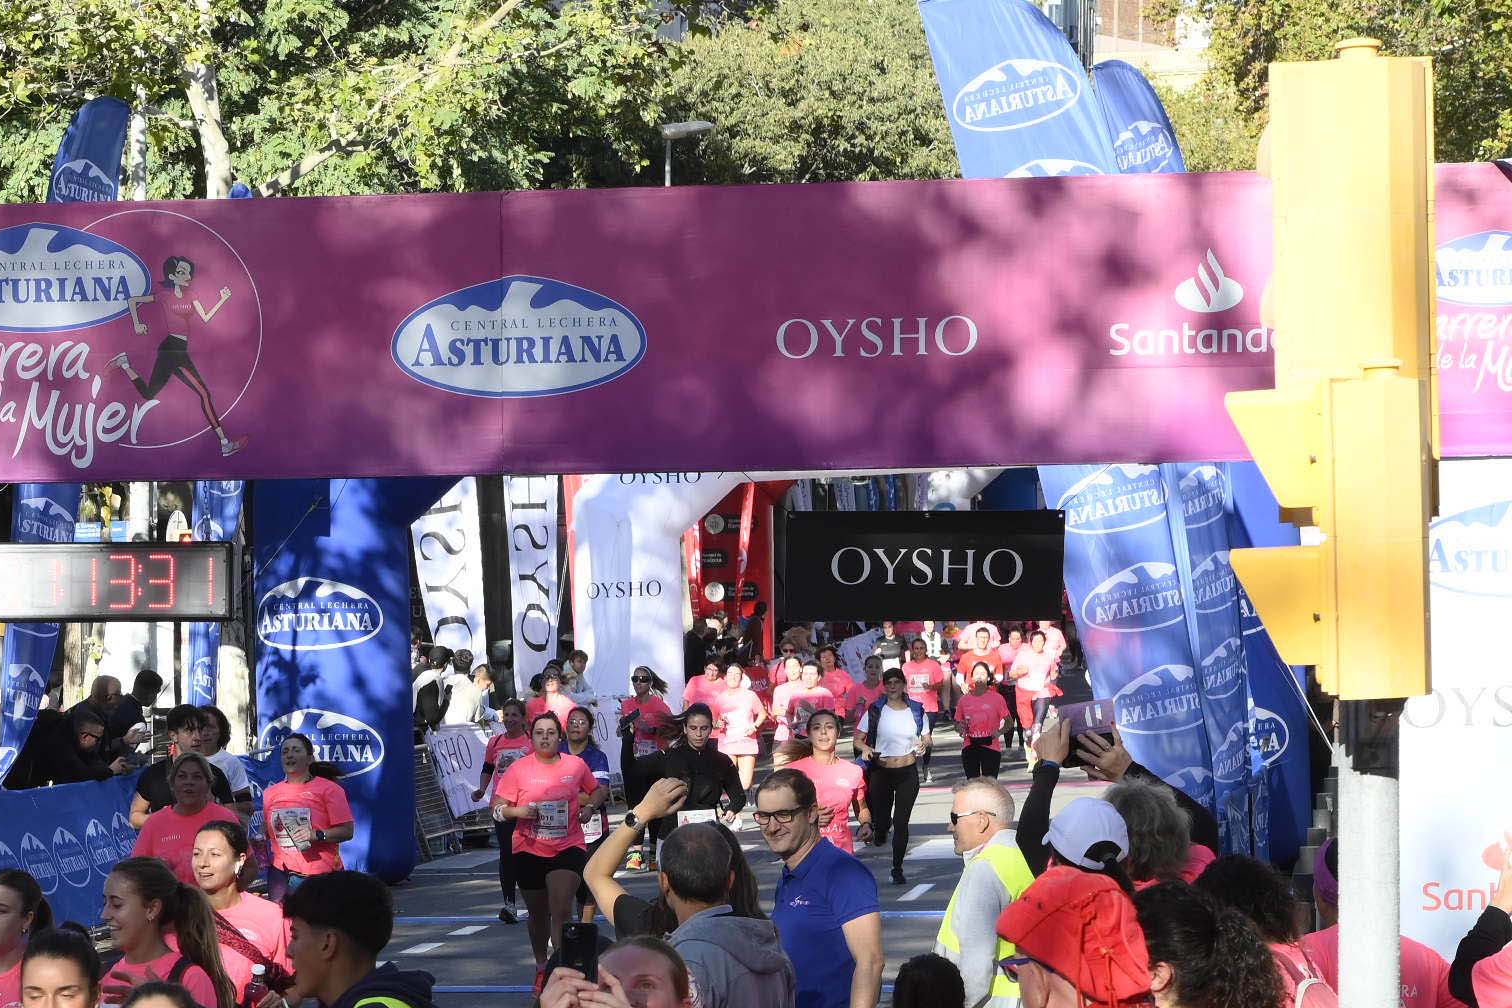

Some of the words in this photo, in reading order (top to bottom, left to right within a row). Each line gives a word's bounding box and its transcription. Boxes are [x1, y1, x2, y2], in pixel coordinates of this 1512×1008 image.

[54, 259, 126, 272] LECHERA
[450, 317, 528, 331] CENTRAL
[536, 316, 618, 330] LECHERA
[775, 315, 978, 360] OYSHO
[412, 322, 626, 369] ASTURIANA
[1109, 323, 1277, 355] Santand
[12, 375, 160, 469] Mujer
[831, 547, 1023, 586] OYSHO
[587, 580, 662, 600] OYSHO
[261, 606, 374, 633] ASTURIANA
[321, 602, 369, 611] LECHERA
